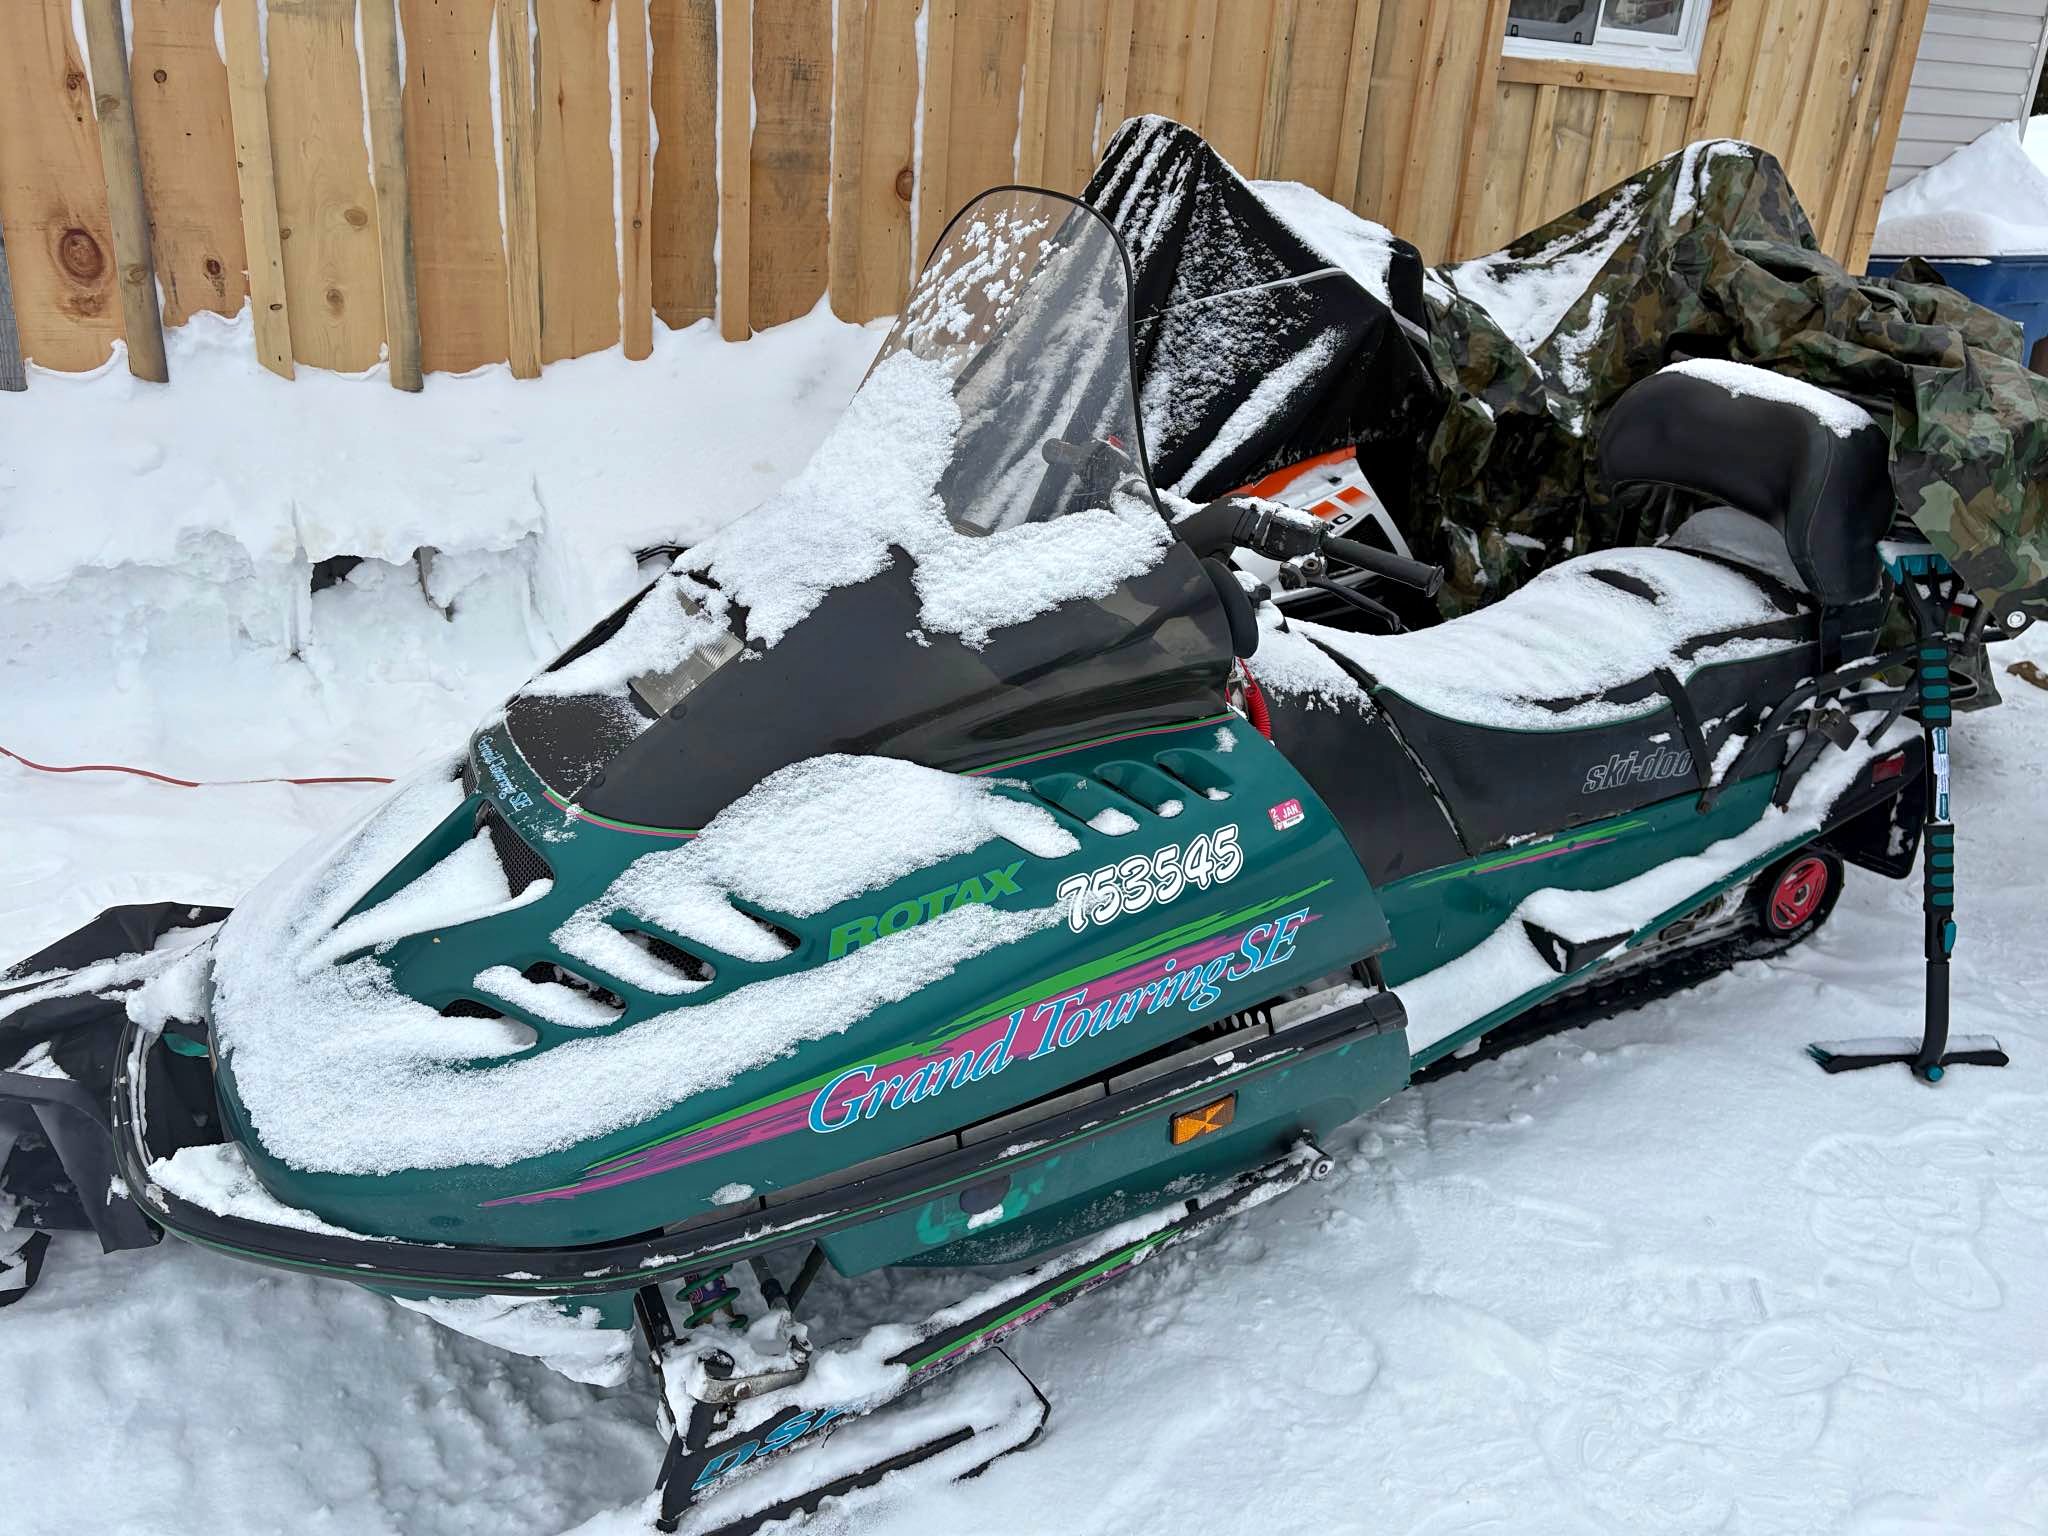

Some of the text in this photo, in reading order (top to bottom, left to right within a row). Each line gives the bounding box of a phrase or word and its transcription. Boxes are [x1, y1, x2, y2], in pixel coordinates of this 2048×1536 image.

[508, 791, 534, 812] SE
[1581, 746, 1694, 794] ski-doo
[1282, 803, 1299, 819] JAN
[827, 859, 1026, 952] ROTAX
[1056, 824, 1243, 934] 753545
[807, 907, 1311, 1134] Grand Touring SE
